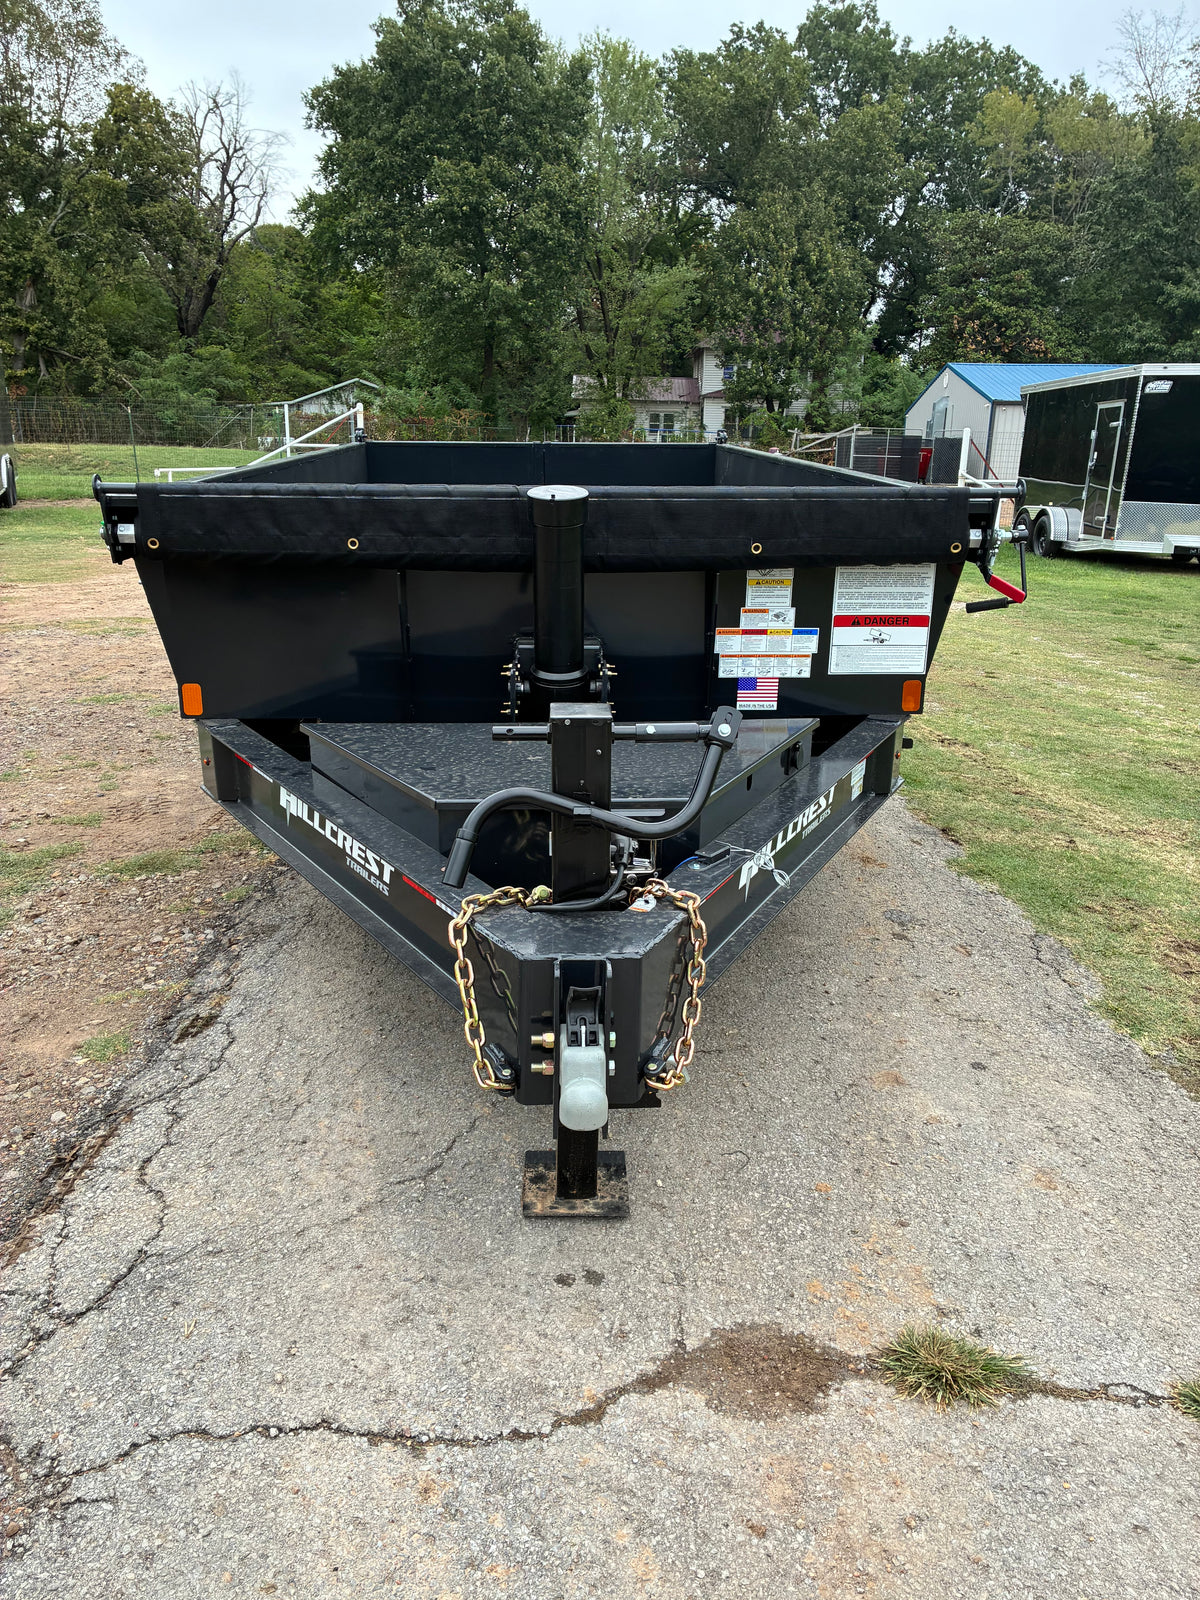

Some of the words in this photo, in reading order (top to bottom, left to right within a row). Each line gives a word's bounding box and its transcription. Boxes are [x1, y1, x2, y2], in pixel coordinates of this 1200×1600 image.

[864, 617, 910, 626] DANGER
[279, 785, 395, 885] HILLCREST
[801, 806, 832, 840] TRAILERS
[345, 856, 390, 897] TRAILERS
